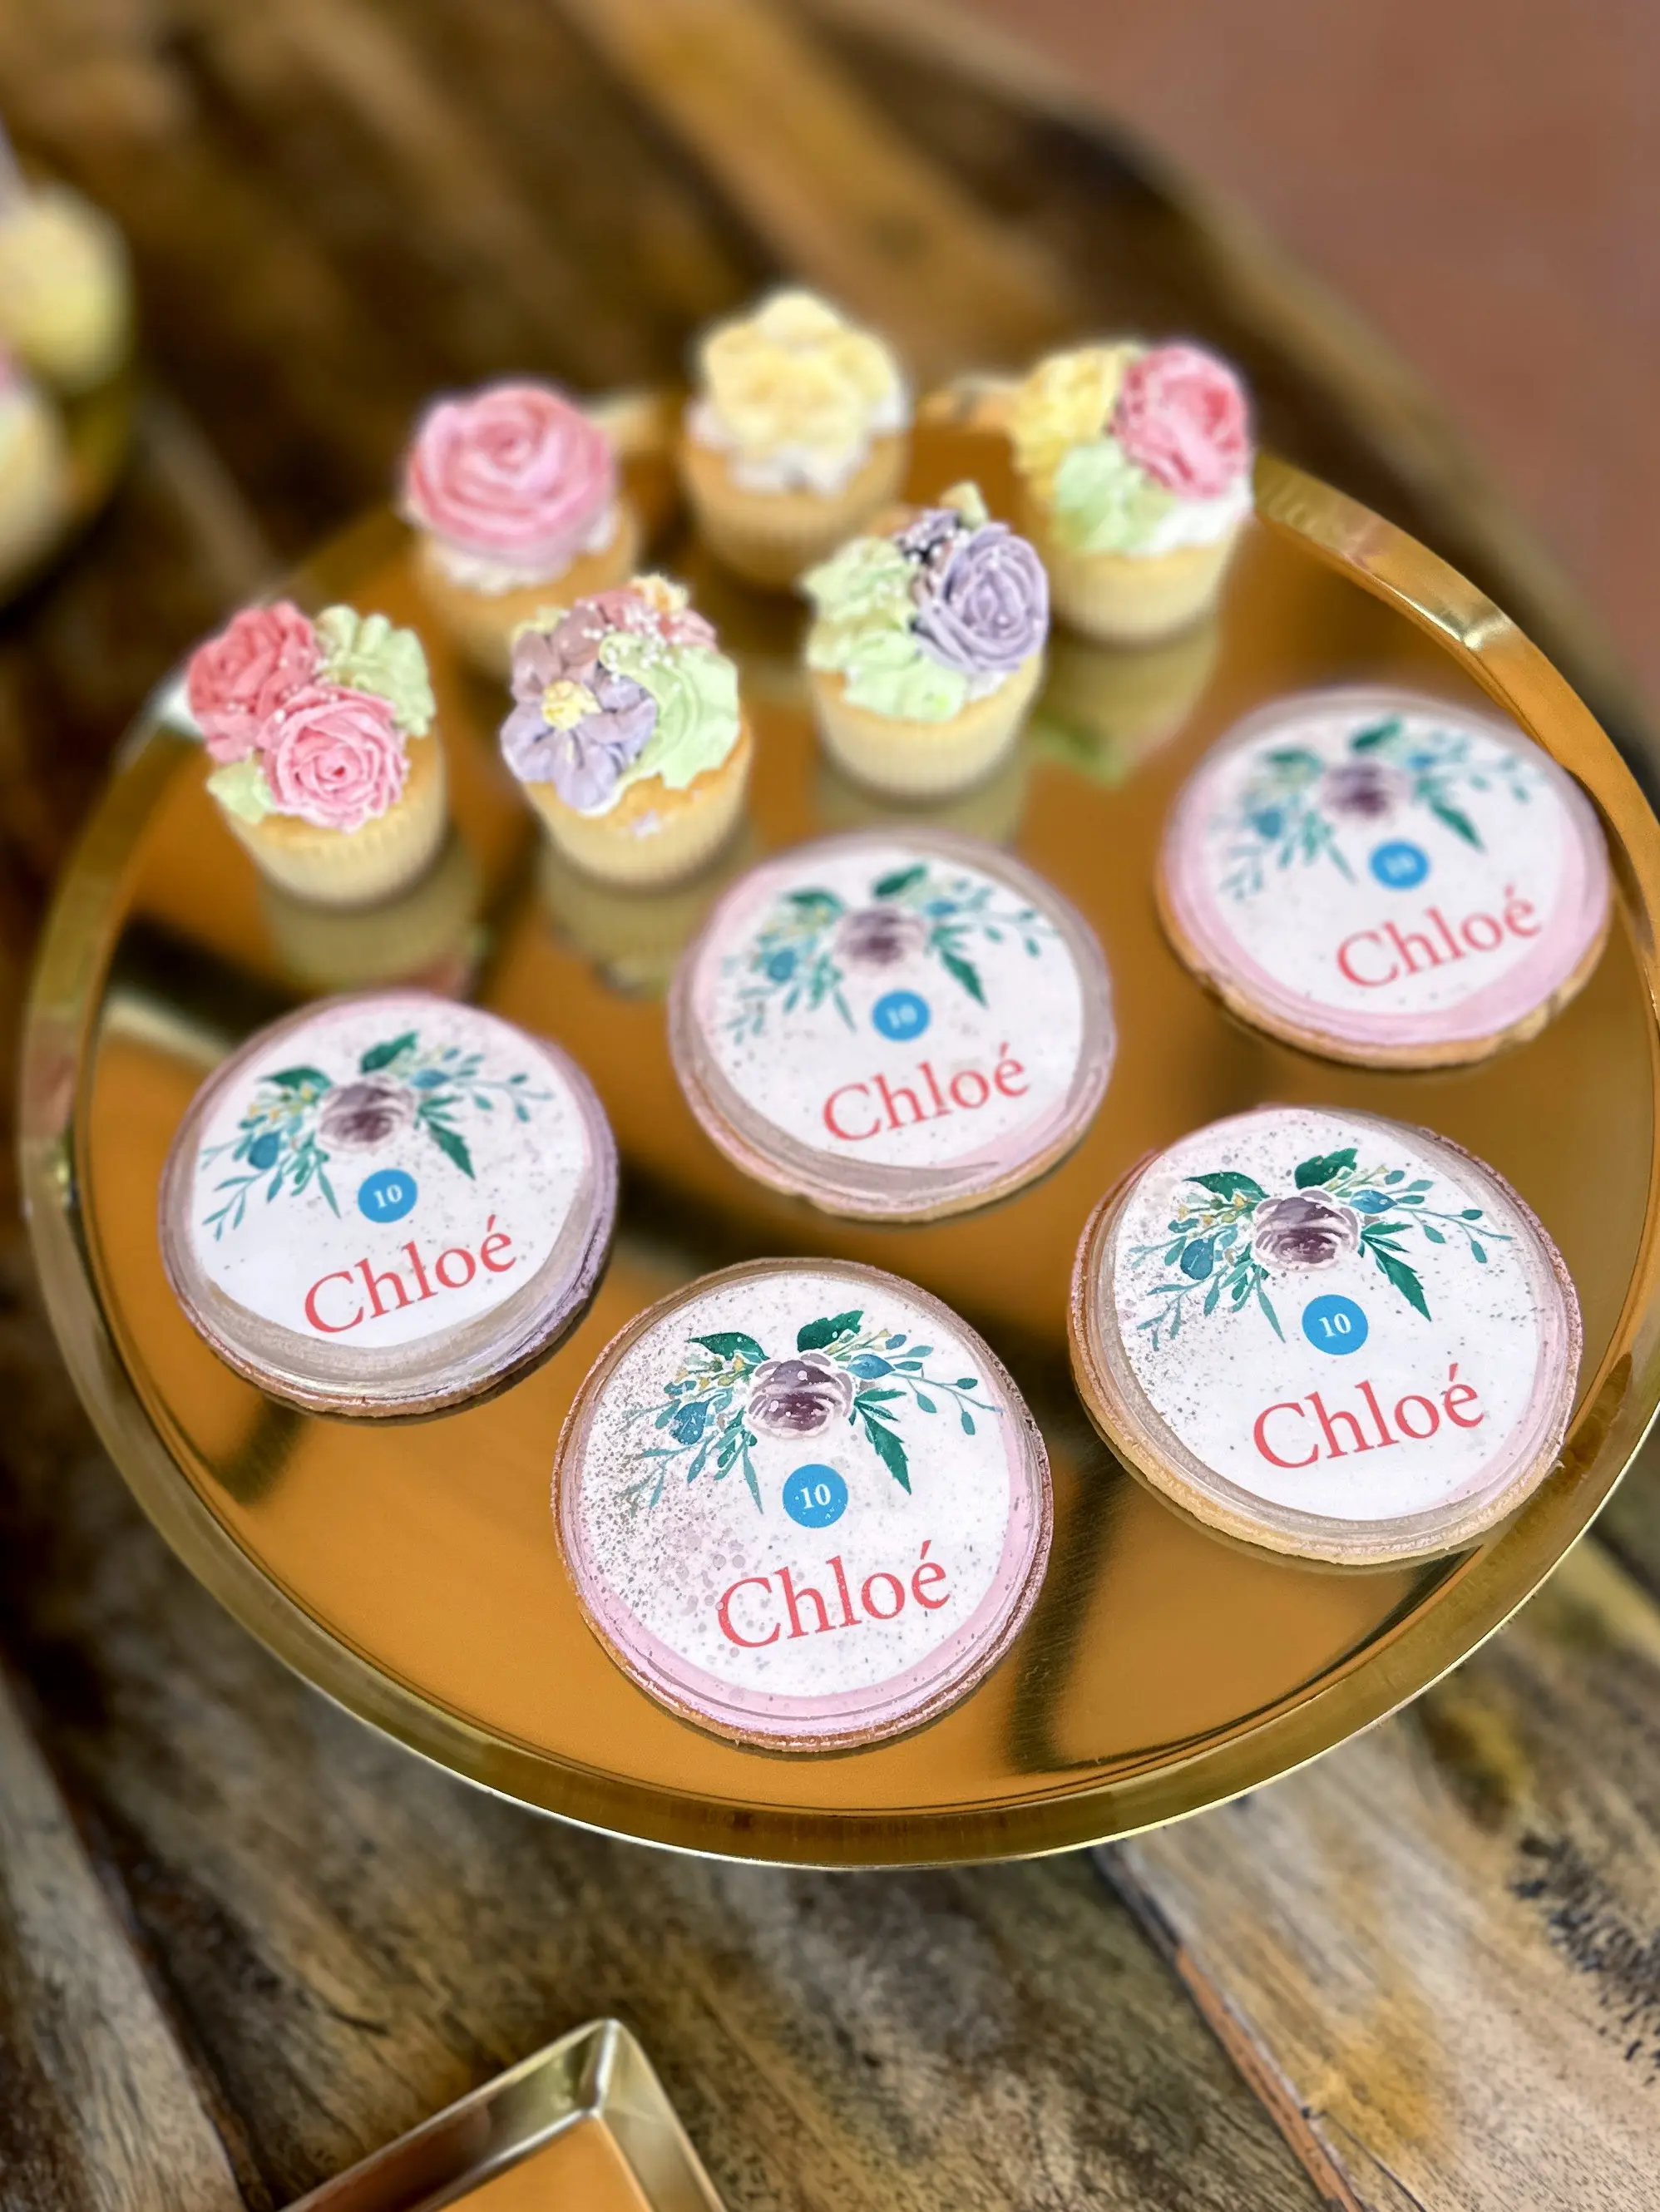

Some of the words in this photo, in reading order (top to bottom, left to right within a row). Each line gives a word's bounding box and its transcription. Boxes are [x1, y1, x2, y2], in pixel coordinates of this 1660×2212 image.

[1336, 884, 1541, 988] Chloé
[822, 1042, 1028, 1143] Chloé
[373, 1184, 403, 1208] 10
[304, 1215, 516, 1334] Chloé
[1319, 1313, 1351, 1337] 10
[1252, 1363, 1485, 1469] Chloé
[800, 1484, 832, 1509] 10
[717, 1540, 951, 1649] Chloé
